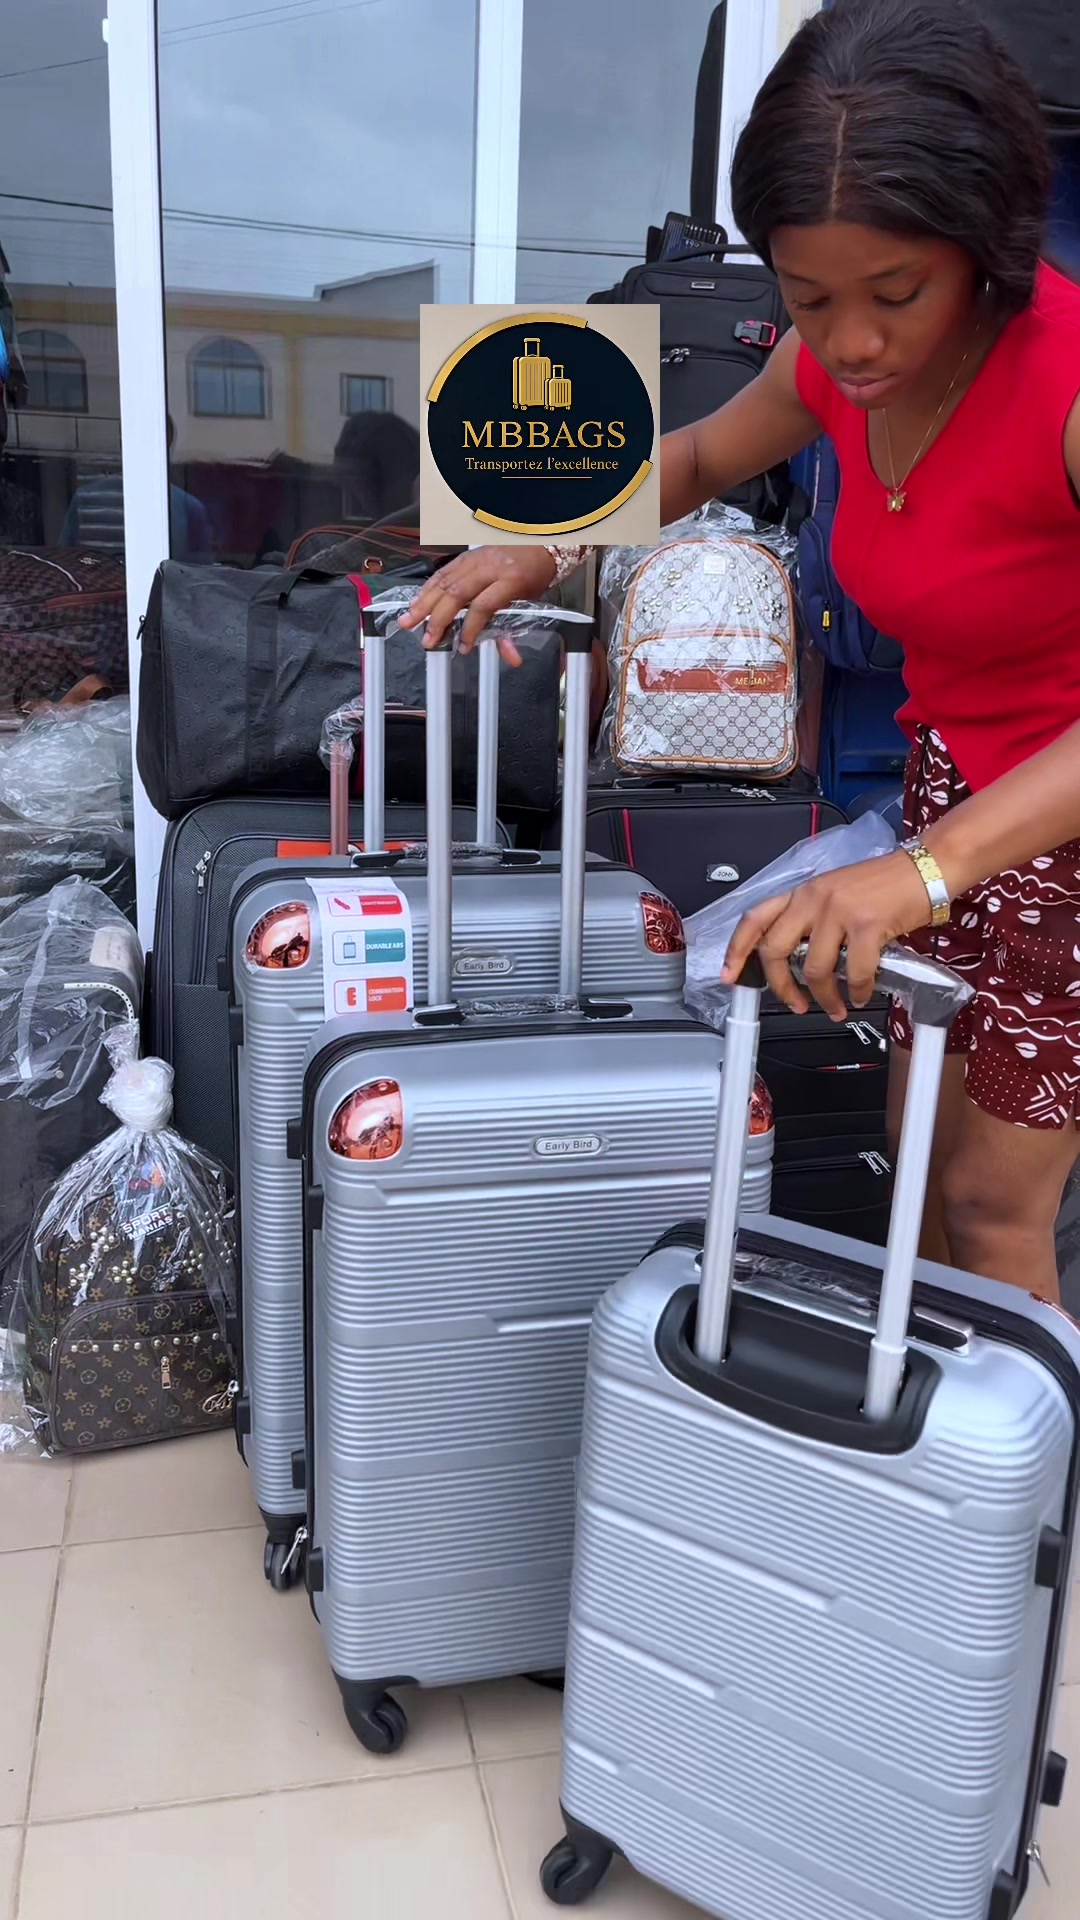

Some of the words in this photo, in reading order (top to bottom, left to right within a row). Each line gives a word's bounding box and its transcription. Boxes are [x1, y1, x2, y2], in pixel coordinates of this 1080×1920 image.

[365, 942, 392, 951] DURABLE
[392, 941, 404, 950] ABS
[464, 961, 484, 971] Early
[487, 960, 504, 970] Bird
[545, 1141, 570, 1152] Early
[573, 1140, 593, 1149] Bird
[122, 1207, 169, 1233] SPORT
[127, 1215, 173, 1241] MANIAS
